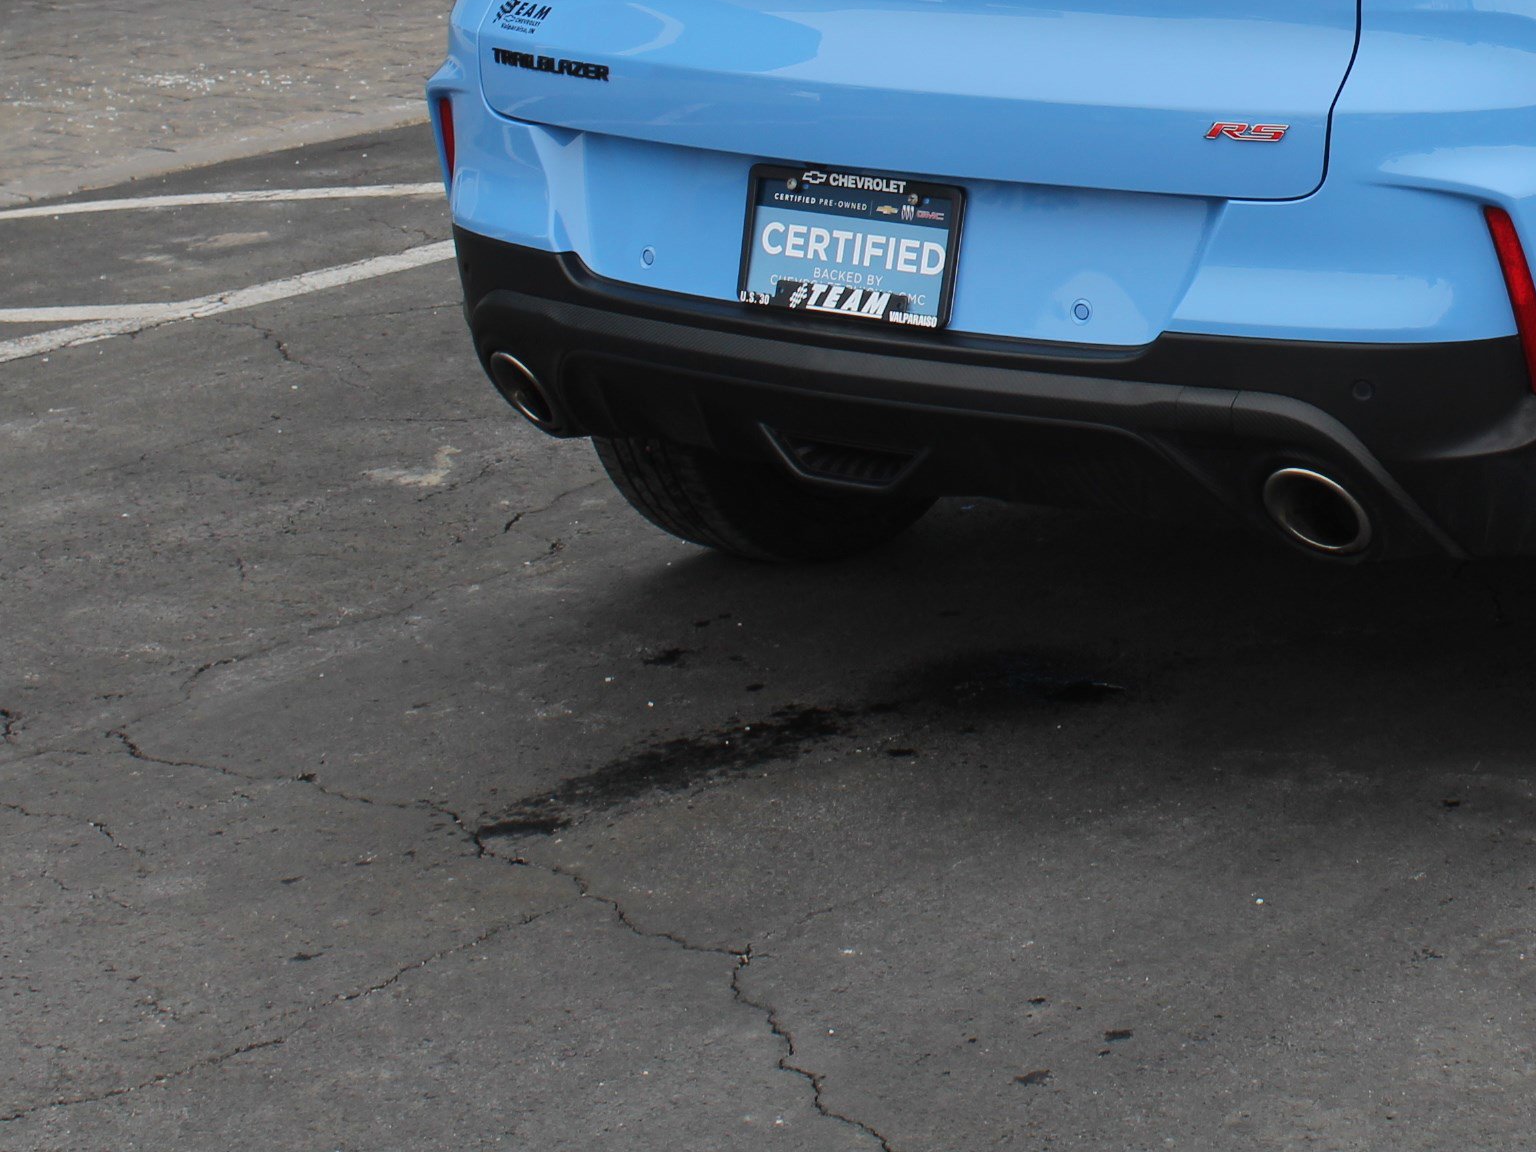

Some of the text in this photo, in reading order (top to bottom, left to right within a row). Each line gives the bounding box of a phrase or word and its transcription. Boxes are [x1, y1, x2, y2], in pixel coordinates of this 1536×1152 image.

[515, 18, 541, 27] CHEVROLET
[492, 47, 610, 82] TRAILBLAZER
[1204, 121, 1290, 142] RS
[829, 173, 906, 194] CHEVROLET
[774, 192, 816, 205] CERTIFIED
[761, 221, 947, 276] CERTIFIED
[813, 267, 862, 283] BACKED
[867, 274, 884, 287] BY
[740, 290, 770, 306] U.S. 30
[806, 283, 890, 316] TEAM
[889, 310, 938, 328] VALPARAISO
